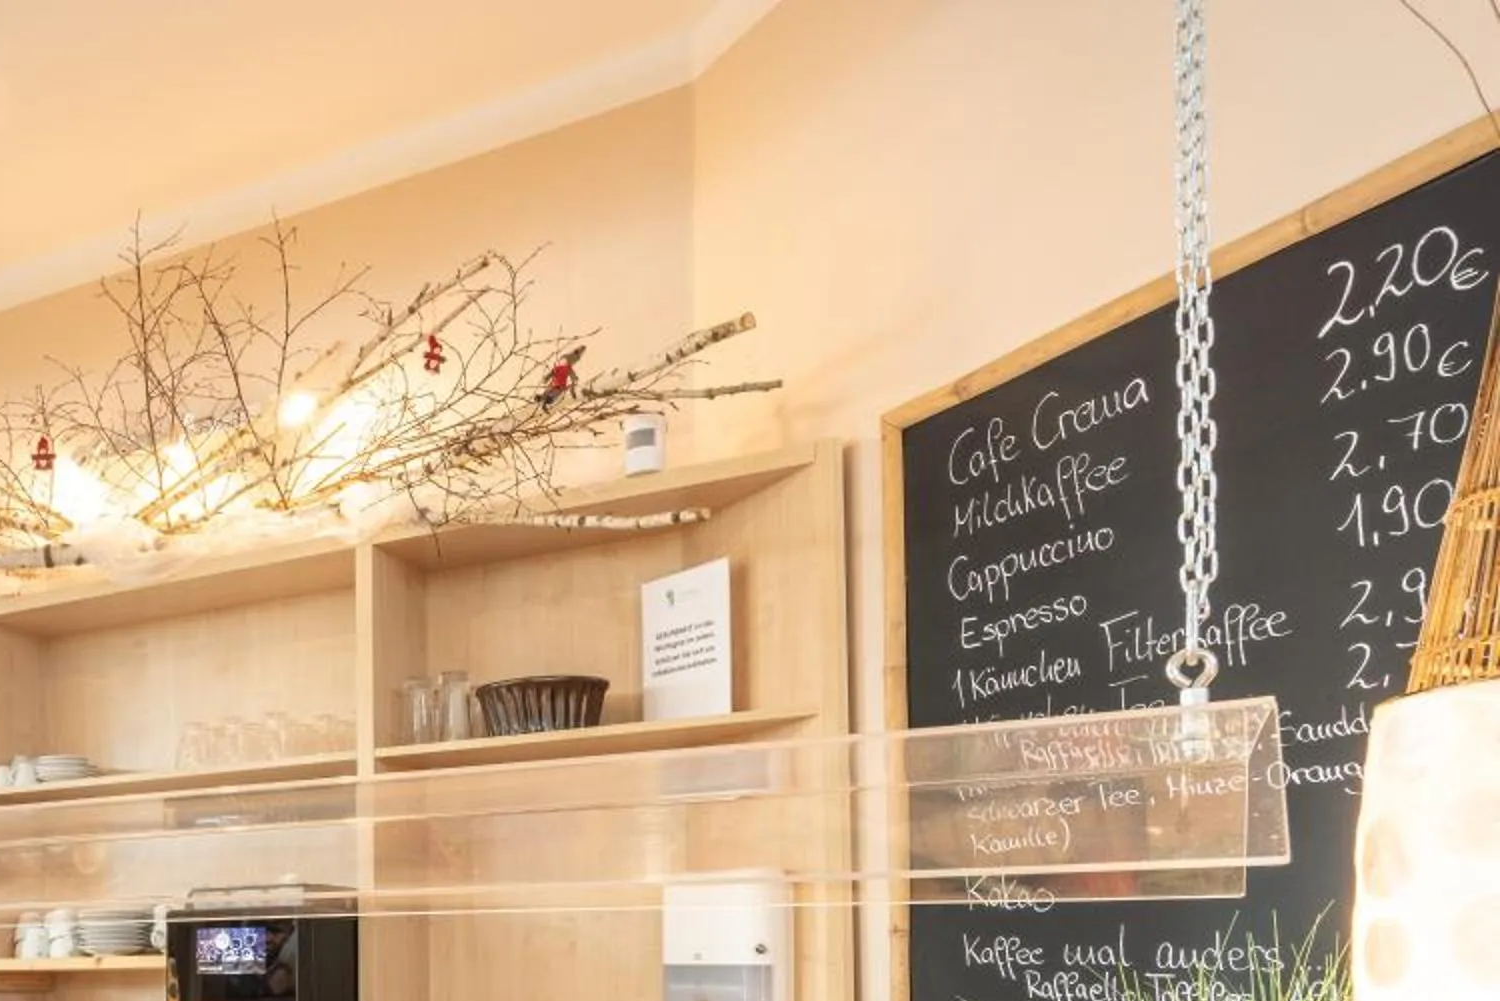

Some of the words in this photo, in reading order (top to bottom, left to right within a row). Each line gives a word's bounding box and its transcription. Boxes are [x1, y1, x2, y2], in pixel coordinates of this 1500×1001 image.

[1030, 377, 1150, 450] Crema
[947, 522, 1116, 604] Cappuccino
[960, 594, 1088, 658] Espresso
[1098, 602, 1294, 673] Filteraffee
[965, 873, 1056, 913] Kakao
[962, 932, 1045, 982] Kaffee
[1062, 922, 1133, 968] mal
